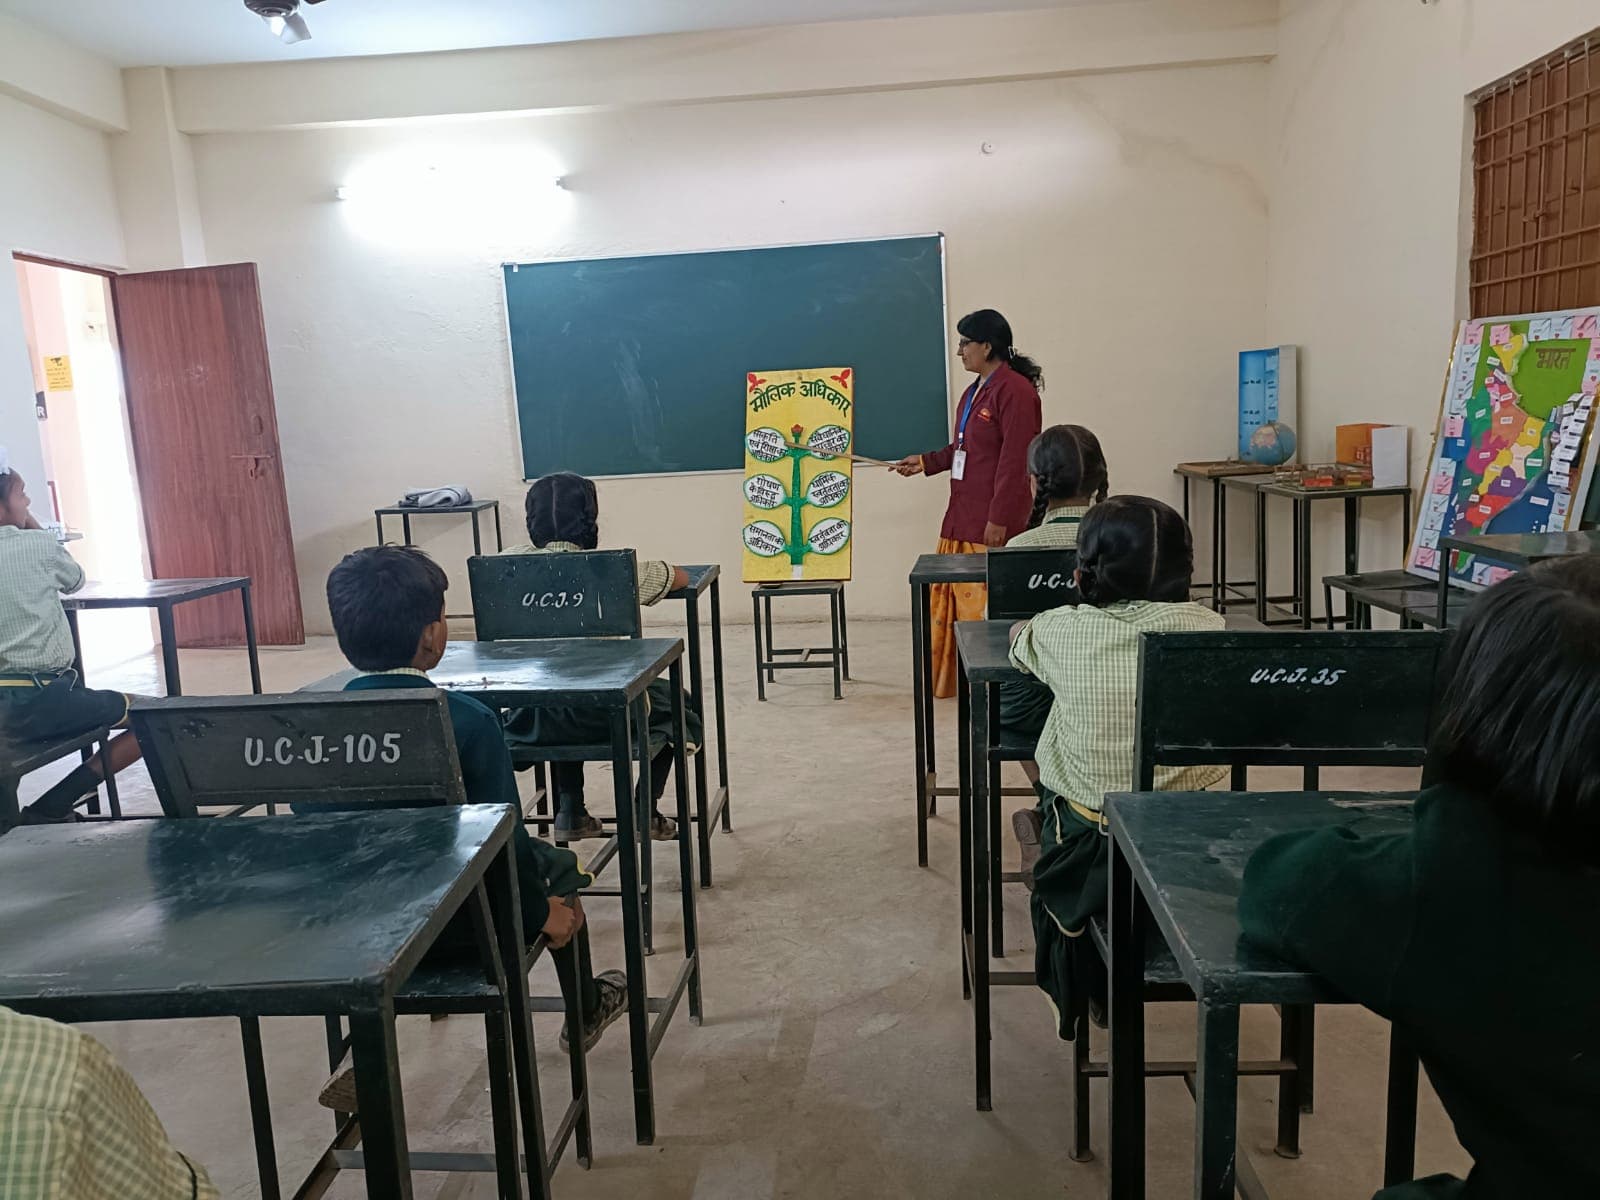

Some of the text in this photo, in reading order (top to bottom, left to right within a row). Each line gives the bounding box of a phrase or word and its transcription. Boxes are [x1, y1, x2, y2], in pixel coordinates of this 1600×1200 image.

[1536, 348, 1576, 370] भारत
[749, 379, 851, 418] मौलिक अधिकार
[812, 473, 836, 488] धार्मिक
[750, 494, 777, 508] अधिकार
[819, 488, 846, 506] अधिकार
[748, 536, 780, 555] अधिकार
[819, 531, 846, 551] अधिकार
